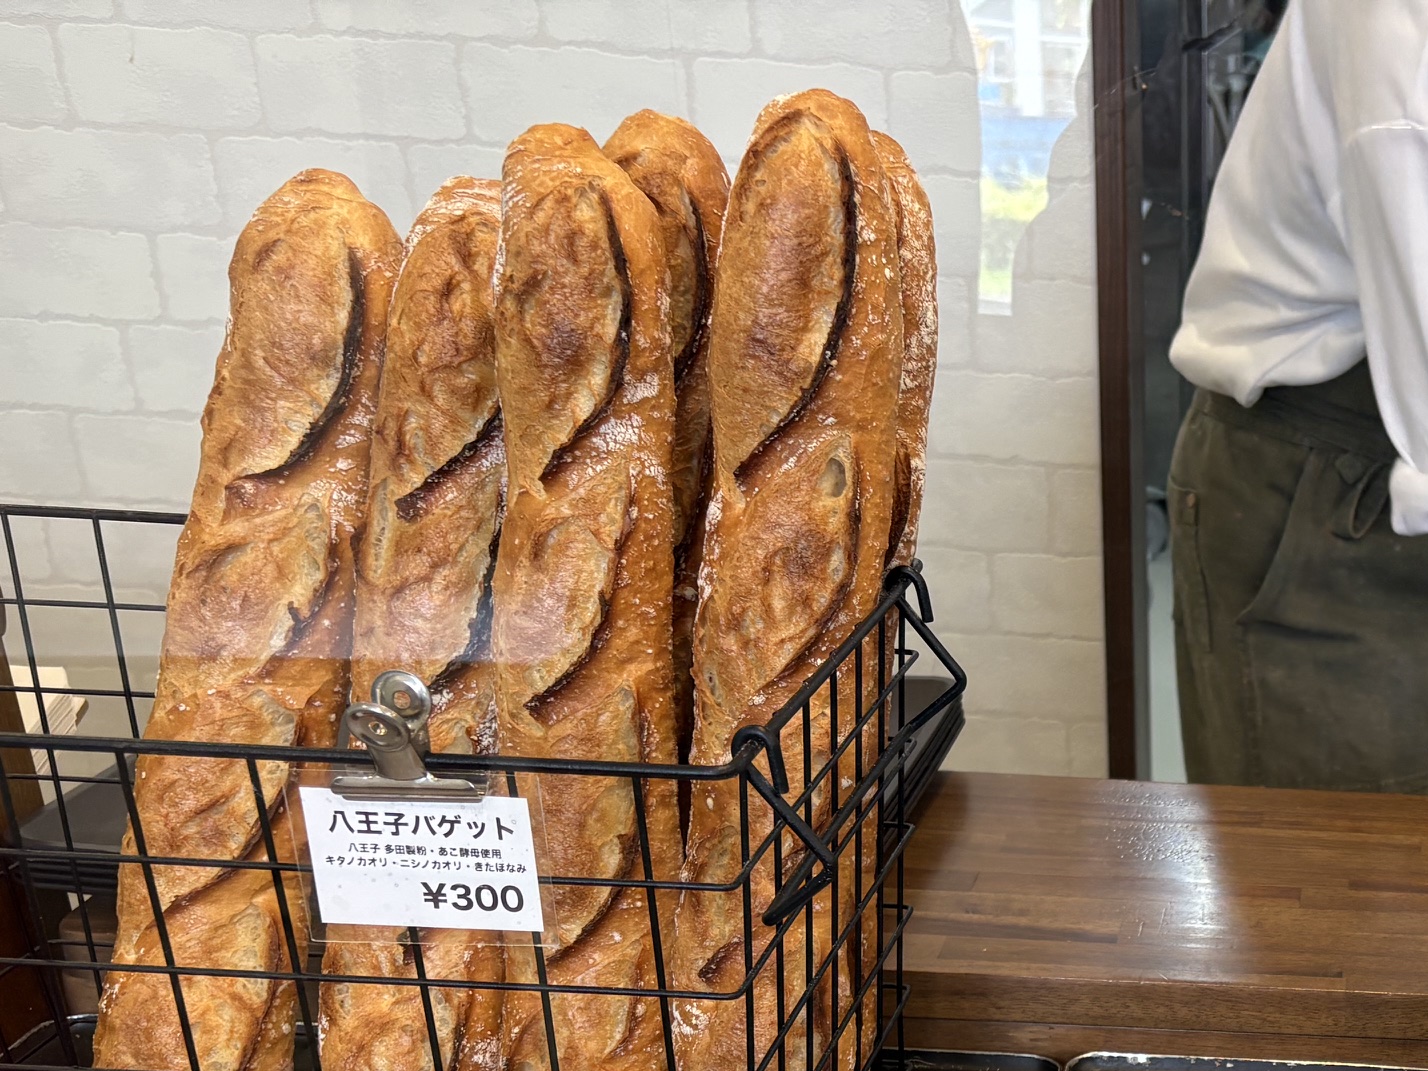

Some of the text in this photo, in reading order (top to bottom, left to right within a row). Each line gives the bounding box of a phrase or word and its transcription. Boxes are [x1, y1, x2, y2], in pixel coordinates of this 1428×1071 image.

[328, 810, 514, 841] 八王子バゲット
[348, 843, 380, 854] 八王子
[421, 881, 525, 913] ¥300
